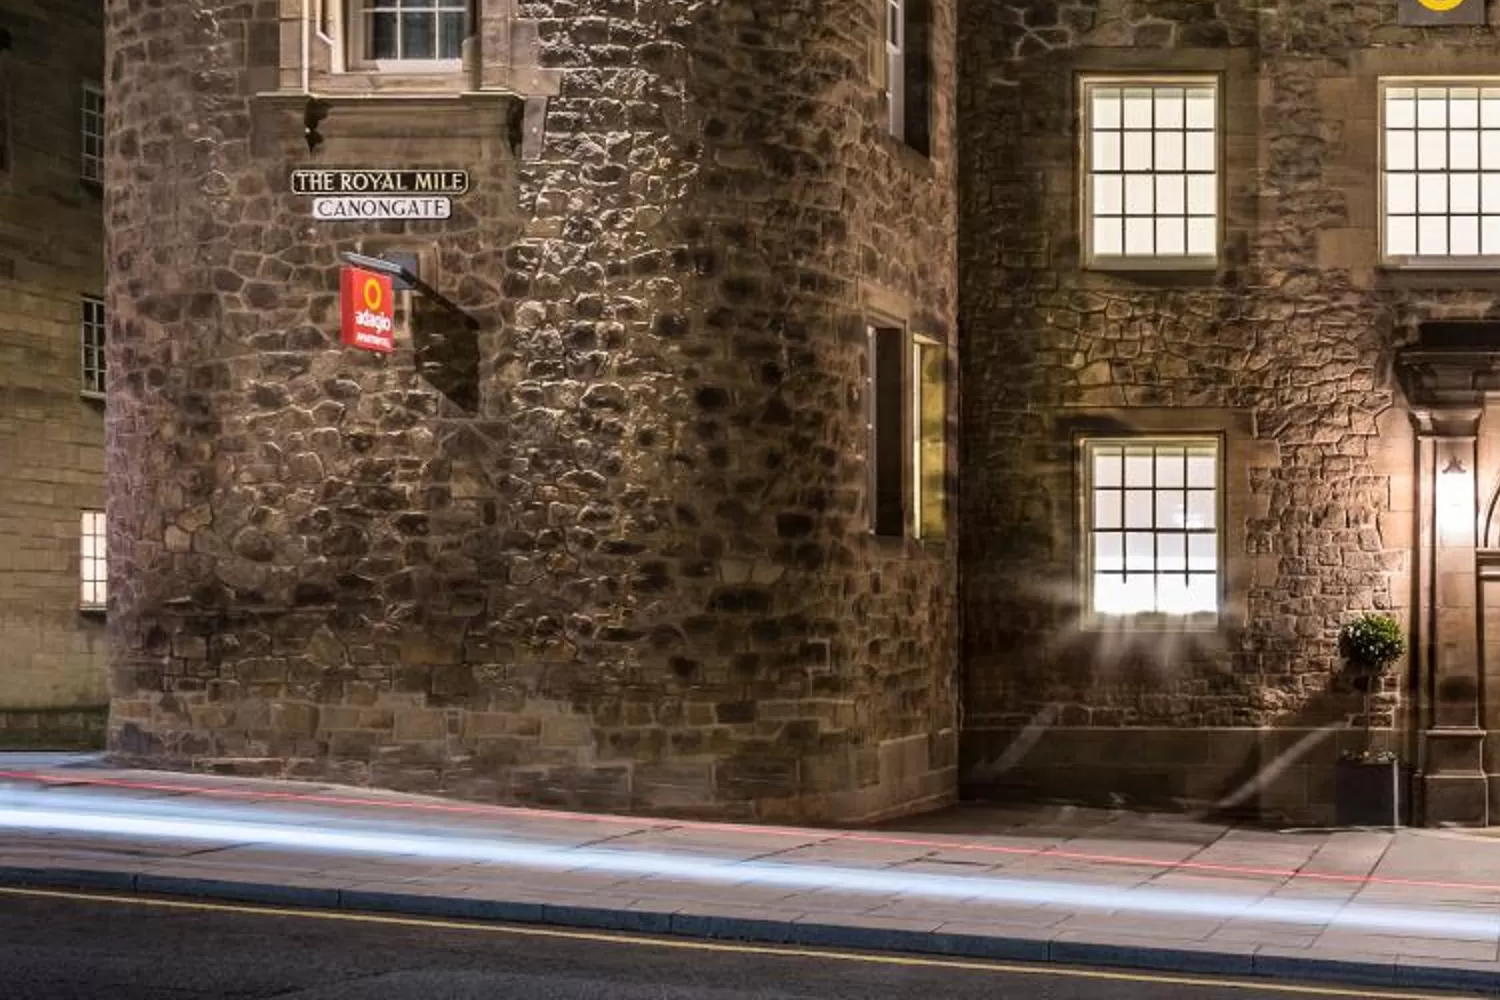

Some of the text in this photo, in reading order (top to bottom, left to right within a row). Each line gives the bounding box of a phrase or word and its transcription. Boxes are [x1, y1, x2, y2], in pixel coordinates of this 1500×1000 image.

[296, 172, 463, 191] THE ROYAL MILE
[317, 199, 445, 217] CANONGATE
[355, 309, 391, 334] adagio
